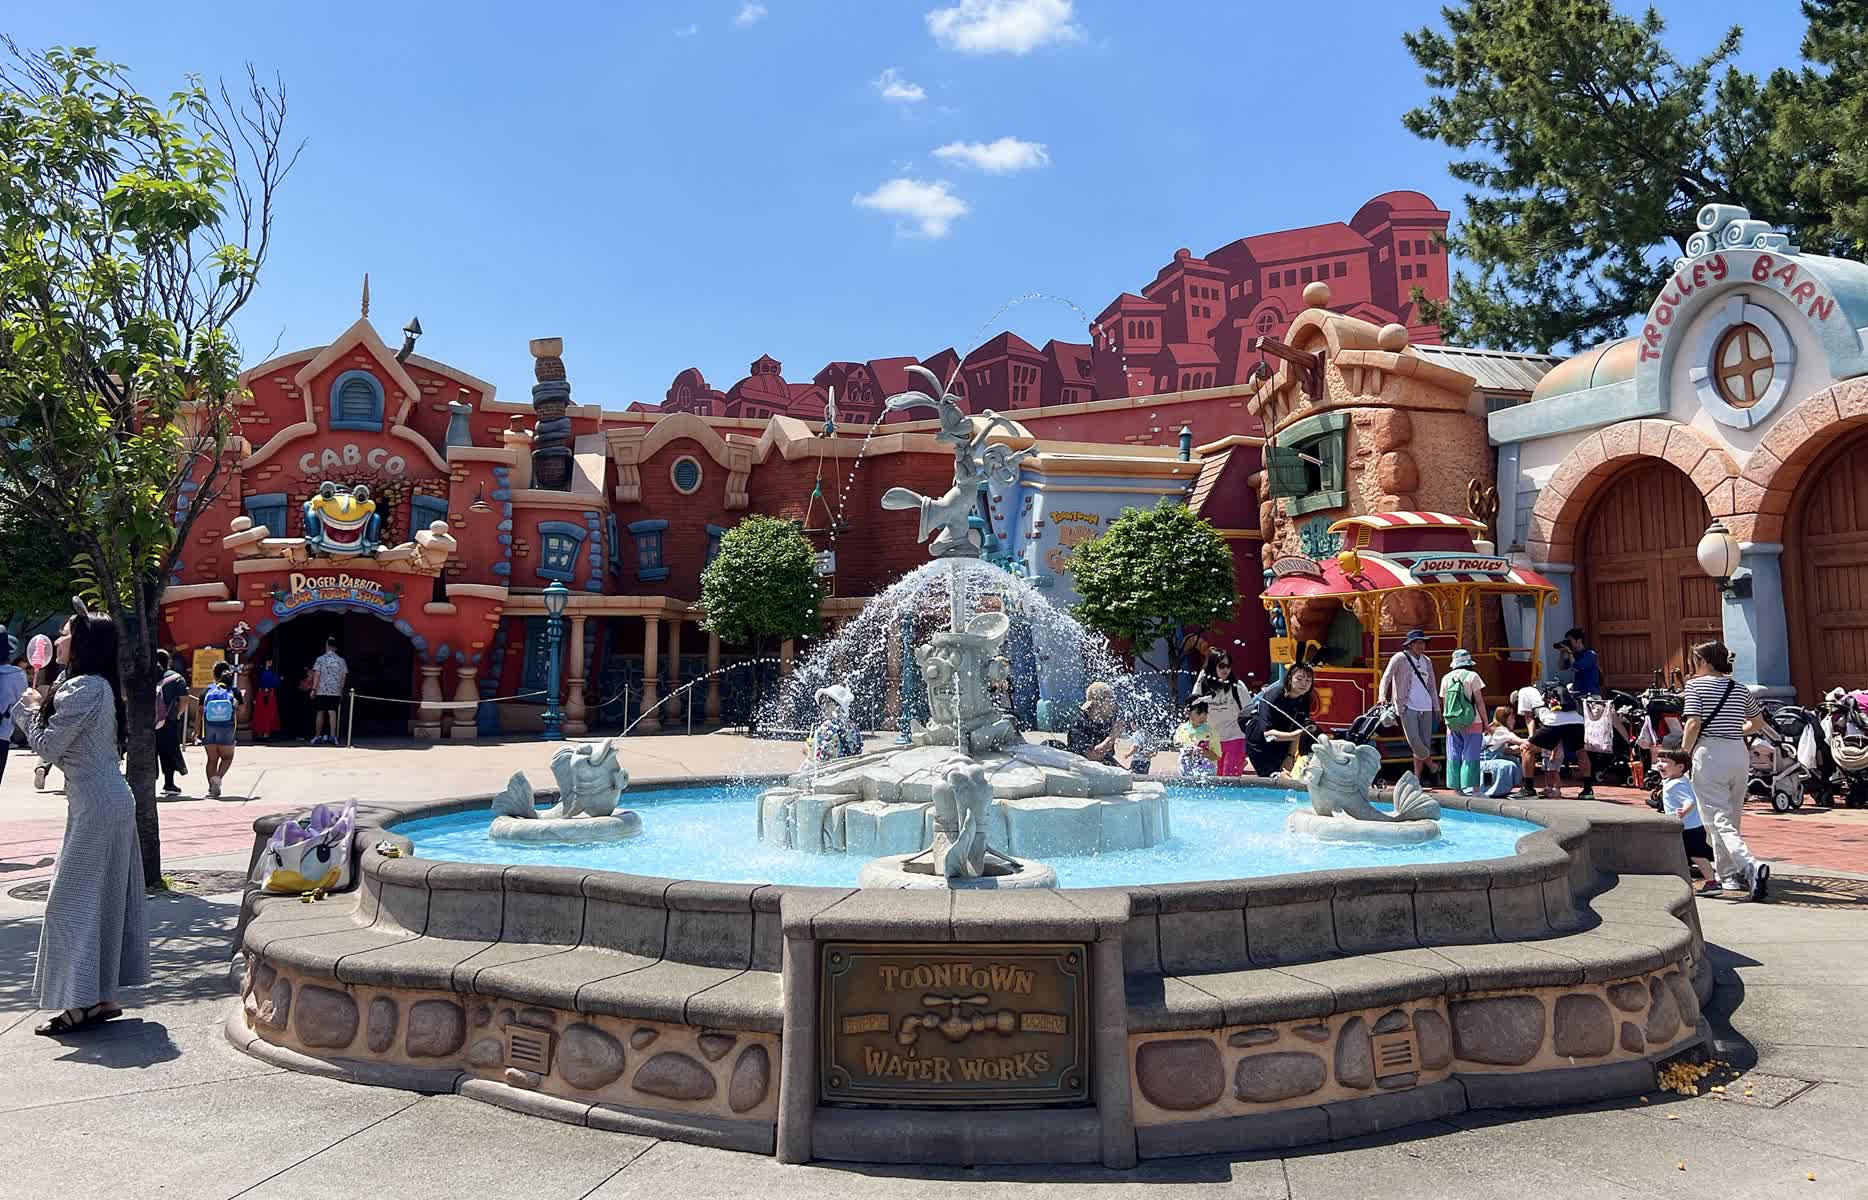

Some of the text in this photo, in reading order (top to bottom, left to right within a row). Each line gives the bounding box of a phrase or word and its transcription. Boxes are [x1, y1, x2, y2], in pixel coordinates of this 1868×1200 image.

[1640, 254, 1834, 362] TROLLEY BARN
[300, 444, 406, 476] CAB CO
[1421, 560, 1502, 571] JOLLY TROLLEY
[290, 573, 336, 599] ROGER
[879, 963, 1034, 994] TOONTOWN
[864, 1046, 1049, 1083] WATER WORKS
